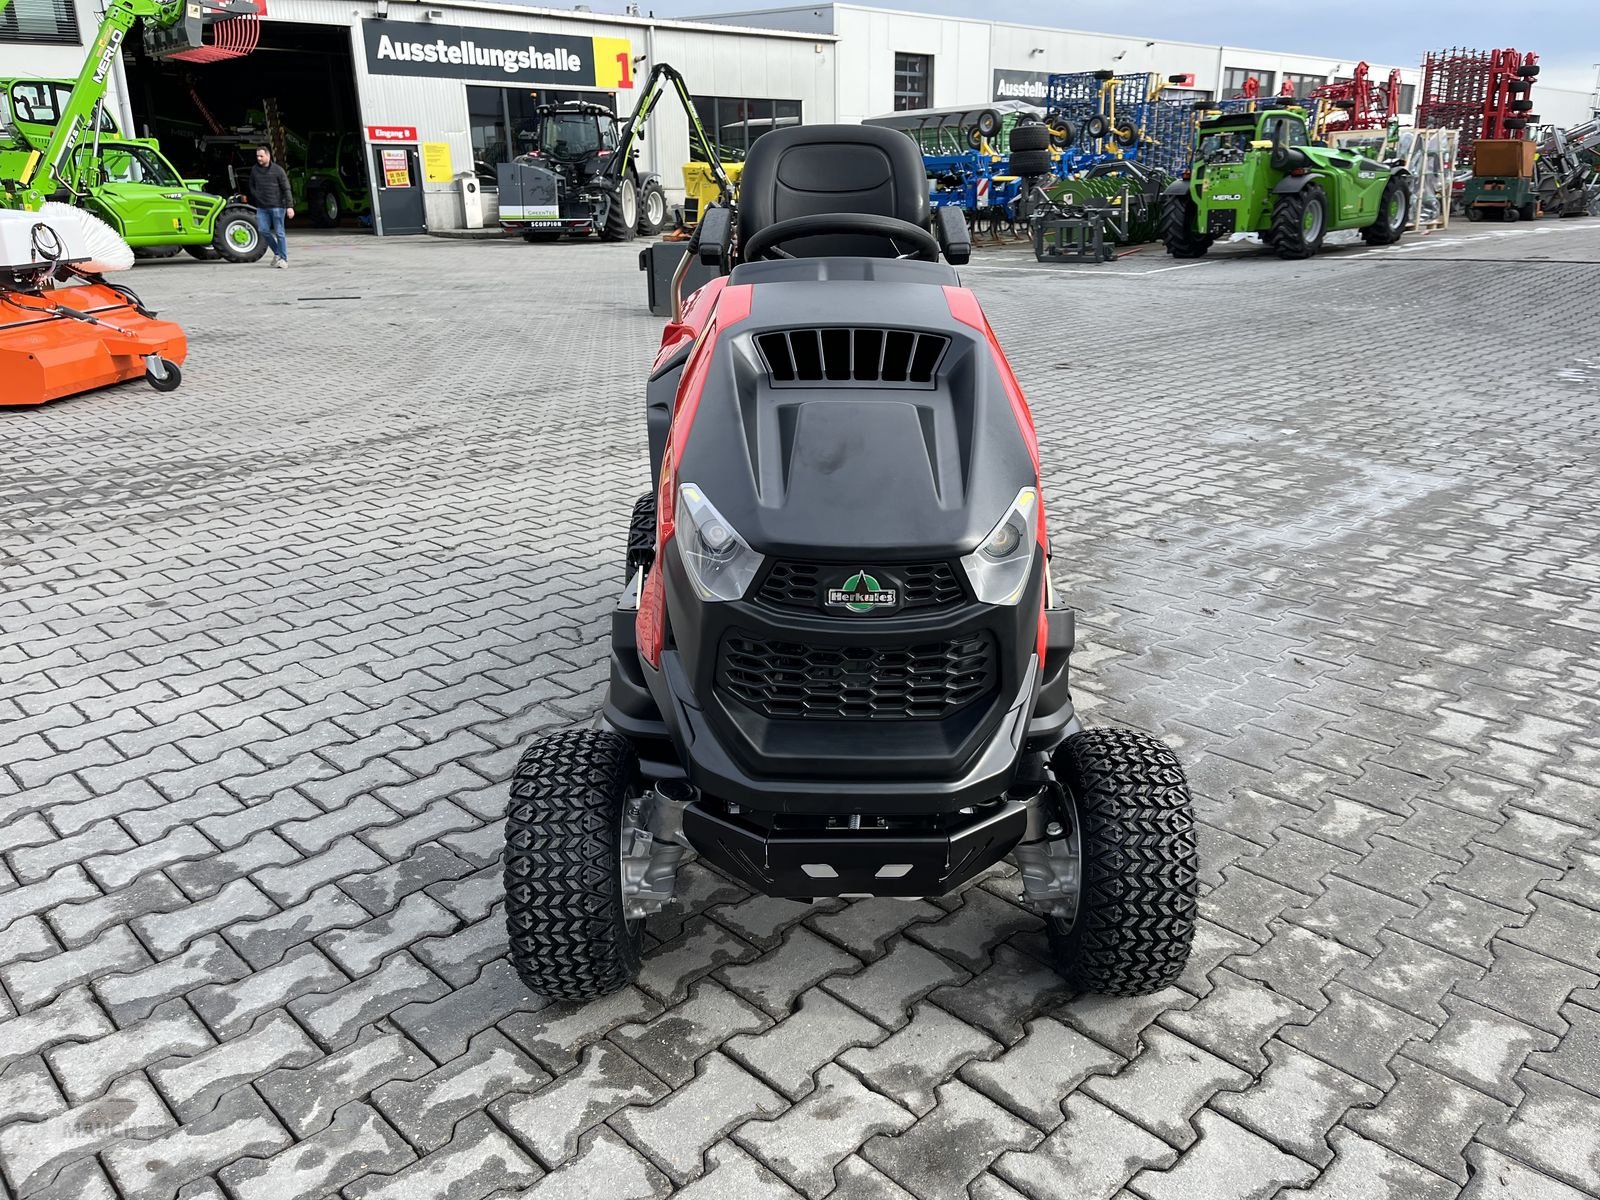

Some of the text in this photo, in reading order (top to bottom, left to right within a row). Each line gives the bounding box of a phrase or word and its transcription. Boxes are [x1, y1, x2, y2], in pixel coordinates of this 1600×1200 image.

[92, 28, 124, 84] MERLO
[376, 34, 634, 89] Ausstellungshalle 1
[374, 129, 404, 139] Eingang
[1212, 193, 1242, 201] MERLO
[831, 592, 894, 602] Herkules
